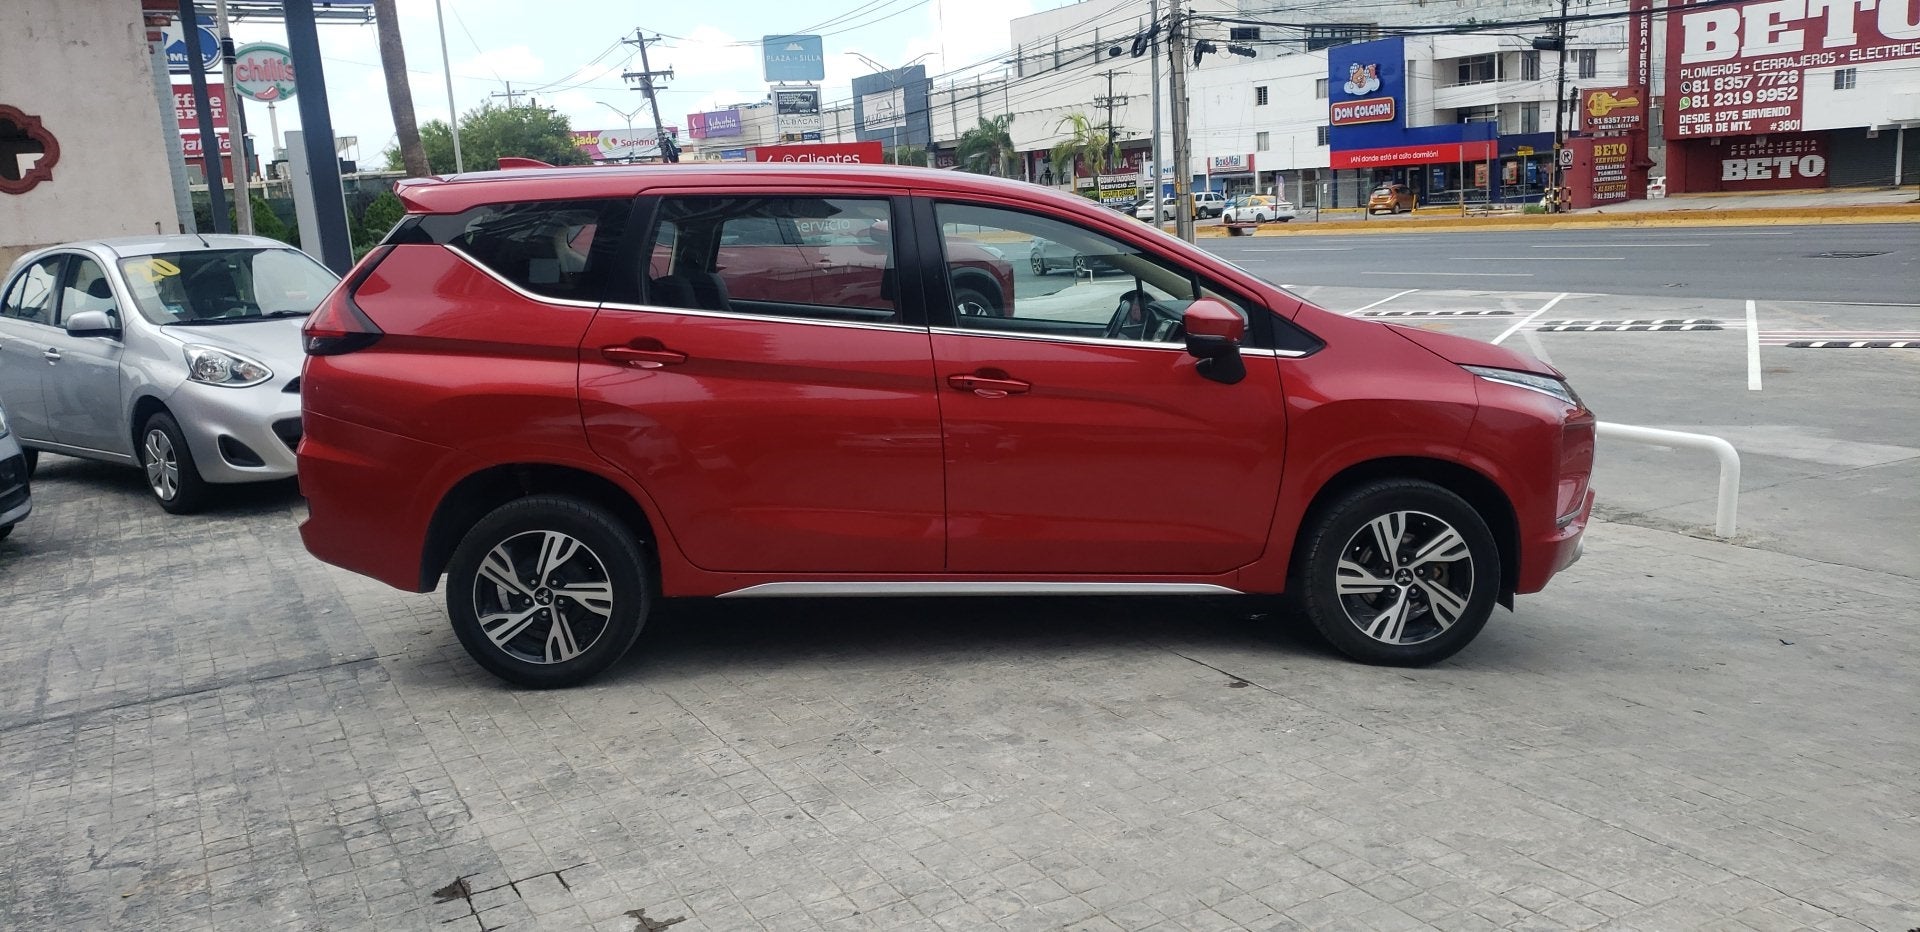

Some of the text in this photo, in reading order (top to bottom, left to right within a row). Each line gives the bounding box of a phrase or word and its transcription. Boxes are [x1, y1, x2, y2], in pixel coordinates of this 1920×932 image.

[799, 54, 821, 62] SILLA
[1681, 62, 1741, 80] PLOMEROS
[1753, 52, 1836, 72] CERRAJEROS
[1692, 69, 1799, 93] 81 8357 7728
[1692, 86, 1798, 108] 81 2319 9952
[1334, 102, 1391, 121] DON COLCHON
[1679, 106, 1791, 124] DESDE 1976 SIRVIENDO
[708, 118, 737, 131] Suburbia
[1679, 119, 1800, 135] EL SUR DE MTY. #3801
[620, 137, 656, 147] Soriana
[1594, 143, 1627, 156] BETO
[1731, 140, 1817, 150] CERRAJERIA
[1731, 147, 1817, 156] FERRETERIA
[1721, 155, 1826, 181] BETO
